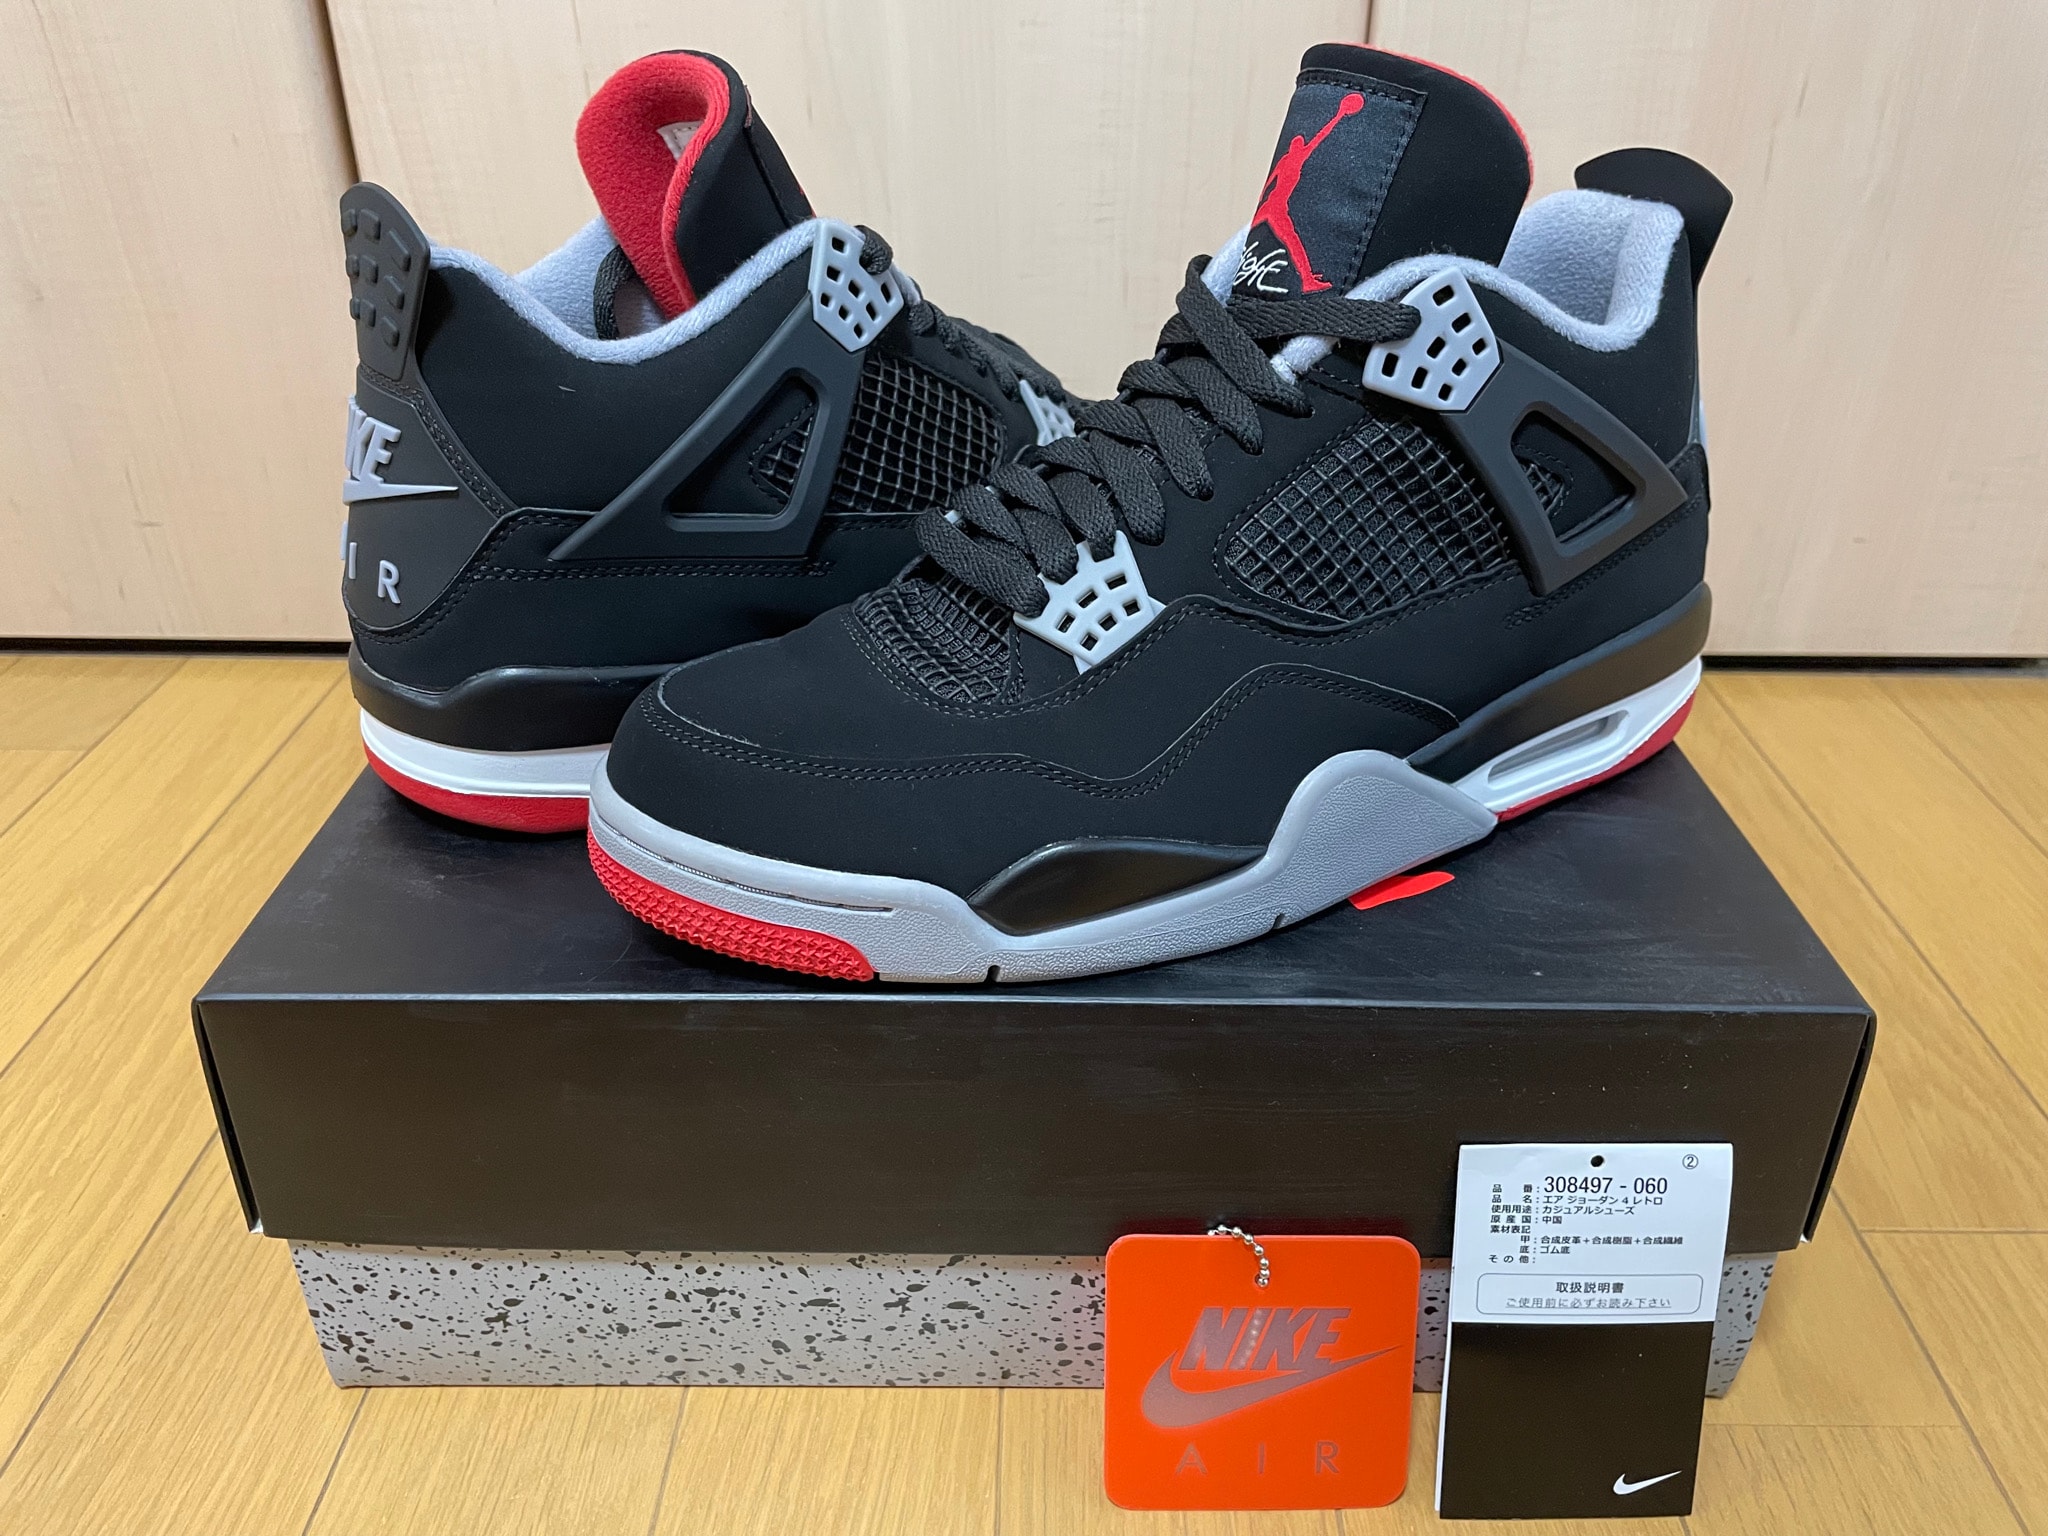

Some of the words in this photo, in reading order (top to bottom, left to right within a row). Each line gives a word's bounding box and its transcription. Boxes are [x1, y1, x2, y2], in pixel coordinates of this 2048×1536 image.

[340, 521, 401, 604] IR
[1544, 1176, 1613, 1194] 308497
[1633, 1177, 1668, 1194] 060
[1490, 1225, 1531, 1234] 素材表記
[1555, 1281, 1625, 1294] 取扱説明書
[1506, 1297, 1672, 1308] ご使用前に必ずお読み下さい
[1178, 1307, 1351, 1371] NIKE
